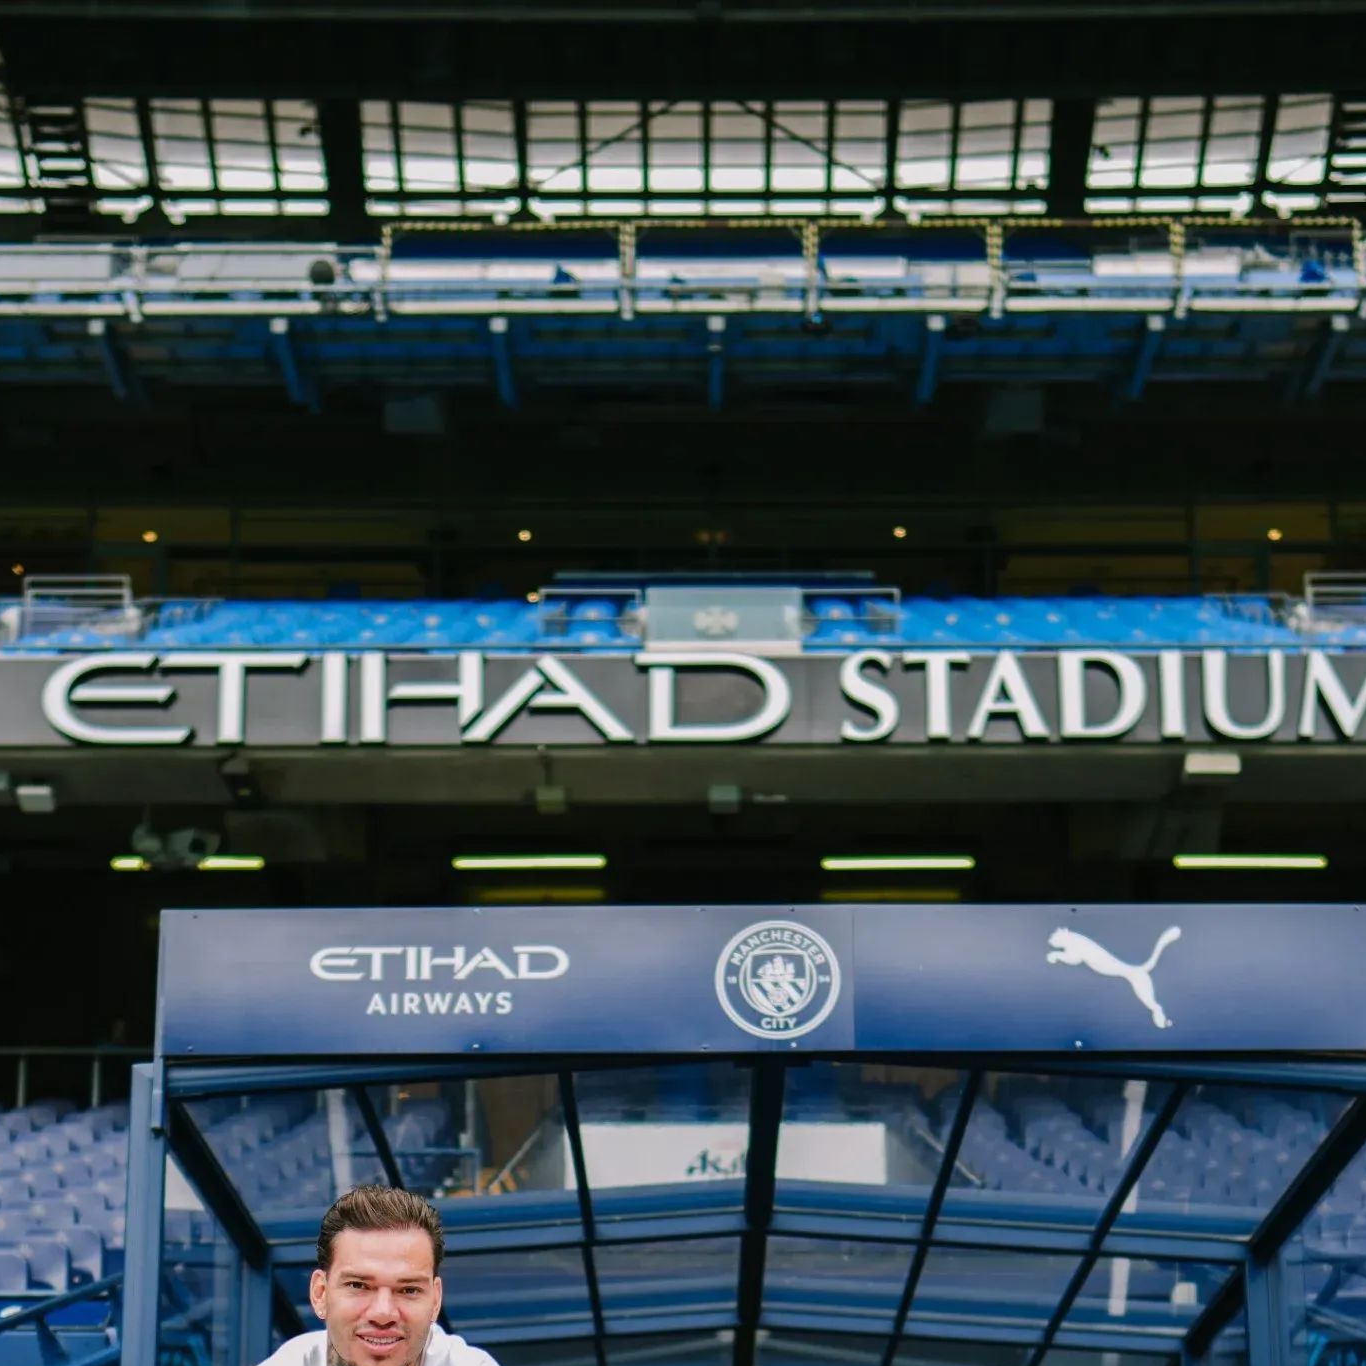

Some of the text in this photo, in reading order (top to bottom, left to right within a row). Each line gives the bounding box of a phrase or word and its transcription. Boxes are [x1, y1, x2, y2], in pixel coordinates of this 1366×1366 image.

[41, 650, 793, 744] ETIHAD
[309, 945, 570, 980] ETIHAD
[730, 929, 826, 967] MANCHESTER
[366, 992, 513, 1015] AIRWAYS
[761, 1018, 797, 1029] CITY
